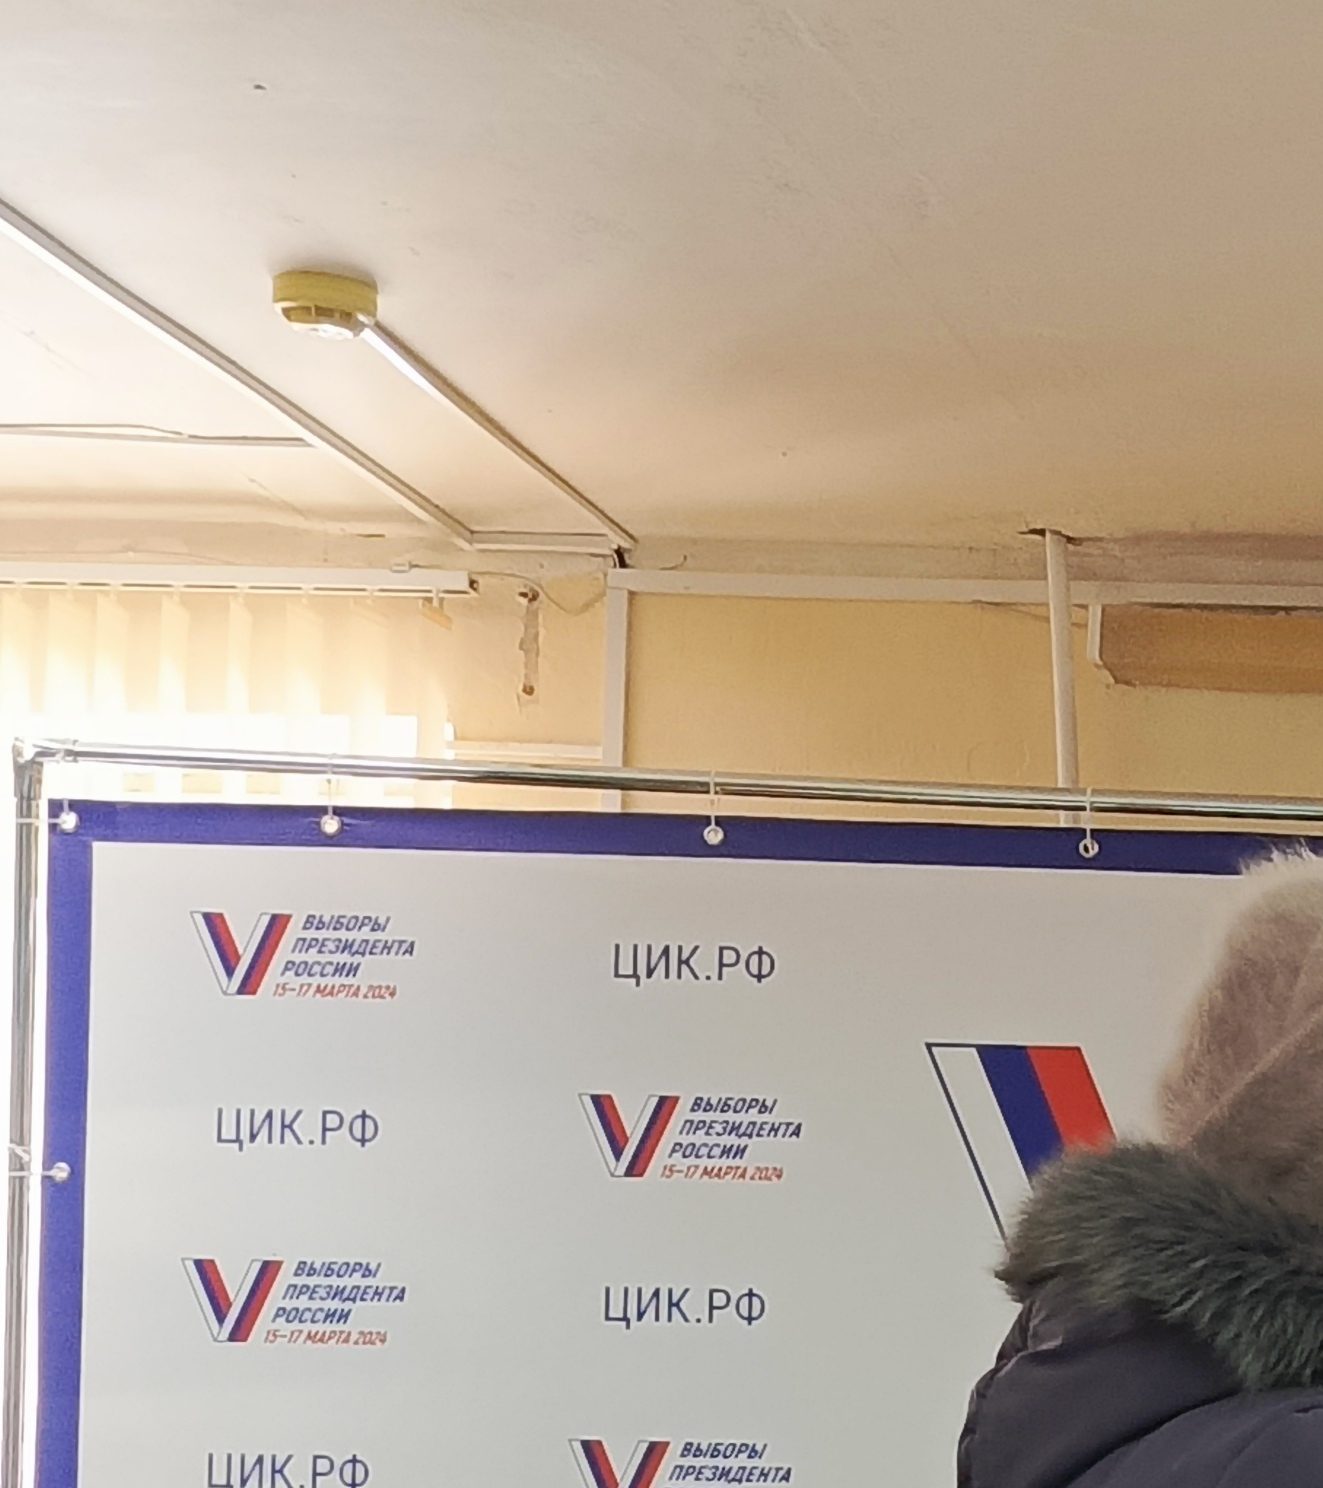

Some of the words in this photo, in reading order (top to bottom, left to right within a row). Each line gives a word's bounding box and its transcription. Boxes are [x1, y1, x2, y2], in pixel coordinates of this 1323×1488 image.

[302, 914, 391, 932] ВЫБОРЫ
[291, 938, 415, 957] ПРЕЗИДЕНТА
[280, 960, 361, 978] РОССИИ
[614, 943, 775, 987] ЦИК.РФ
[313, 983, 360, 998] МАРТА
[363, 985, 396, 999] 2024
[689, 1097, 777, 1115] ВЫБОРЫ
[217, 1108, 379, 1152] ЦИК.РФ
[679, 1119, 802, 1139] ПРЕЗИДЕНТА
[668, 1142, 748, 1160] РОССИИ
[699, 1165, 748, 1180] МАРТА
[750, 1166, 783, 1181] 2024
[293, 1261, 381, 1278] ВЫБОРЫ
[282, 1284, 406, 1304] ПРЕЗИДЕНТА
[271, 1307, 352, 1325] РОССИИ
[604, 1286, 765, 1330] ЦИК.РФ
[303, 1330, 351, 1345] МАРТА
[353, 1331, 387, 1345] 2024
[679, 1442, 767, 1459] ВЫБОРЫ
[668, 1465, 792, 1485] ПРЕЗИДЕНТА
